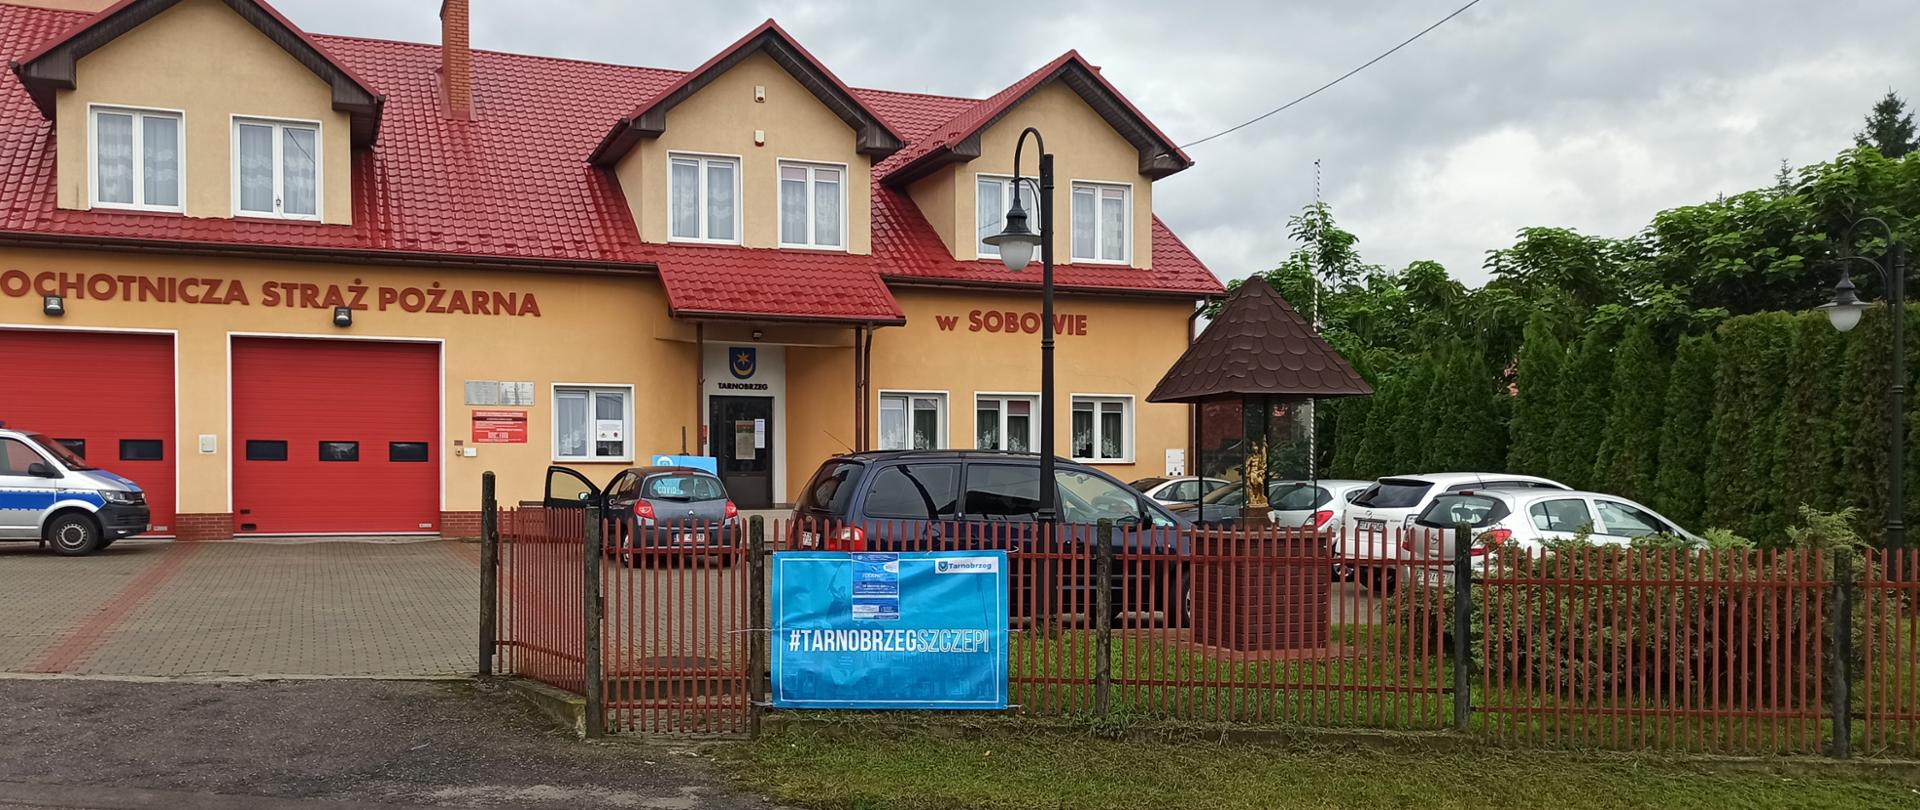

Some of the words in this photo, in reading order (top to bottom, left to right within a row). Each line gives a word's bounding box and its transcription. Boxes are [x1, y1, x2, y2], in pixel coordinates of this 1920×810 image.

[0, 269, 250, 306] OCHOTNICZA
[261, 278, 369, 311] STRAŻ
[378, 281, 541, 318] POŻARNA
[935, 315, 960, 332] w
[718, 382, 769, 391] TARNOBRZEG
[789, 628, 990, 653] #TARNOBRZEGSZCZEPI
